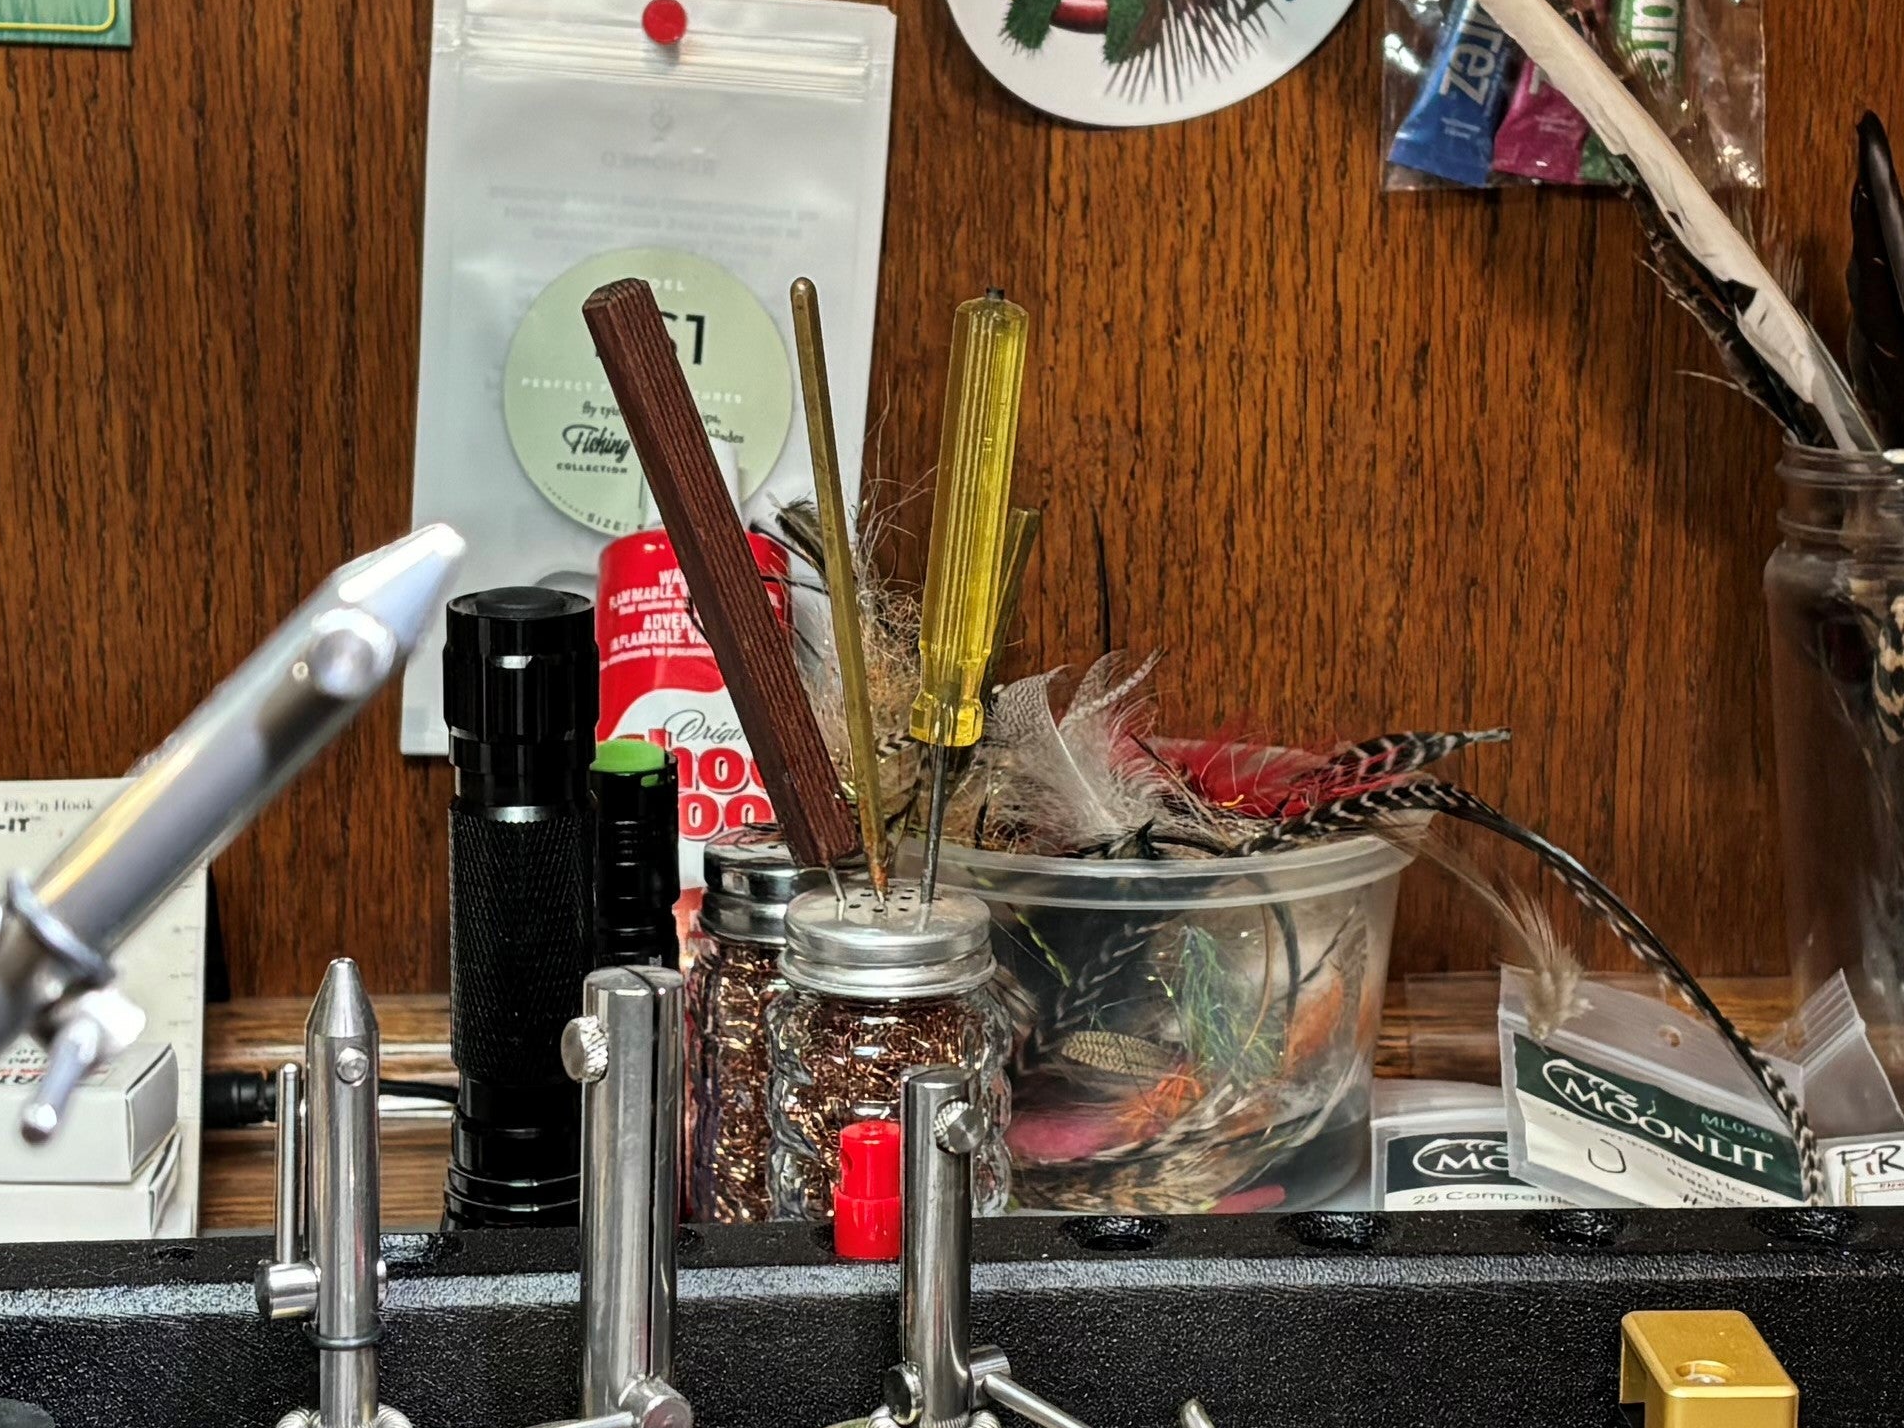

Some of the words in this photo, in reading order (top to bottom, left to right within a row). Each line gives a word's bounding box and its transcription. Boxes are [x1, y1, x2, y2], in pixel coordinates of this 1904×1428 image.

[521, 377, 593, 392] PERFECT
[556, 462, 628, 474] COLLECTION
[54, 800, 94, 812] Hook
[1565, 1077, 1773, 1173] MOONLIT
[1412, 1192, 1439, 1206] 25
